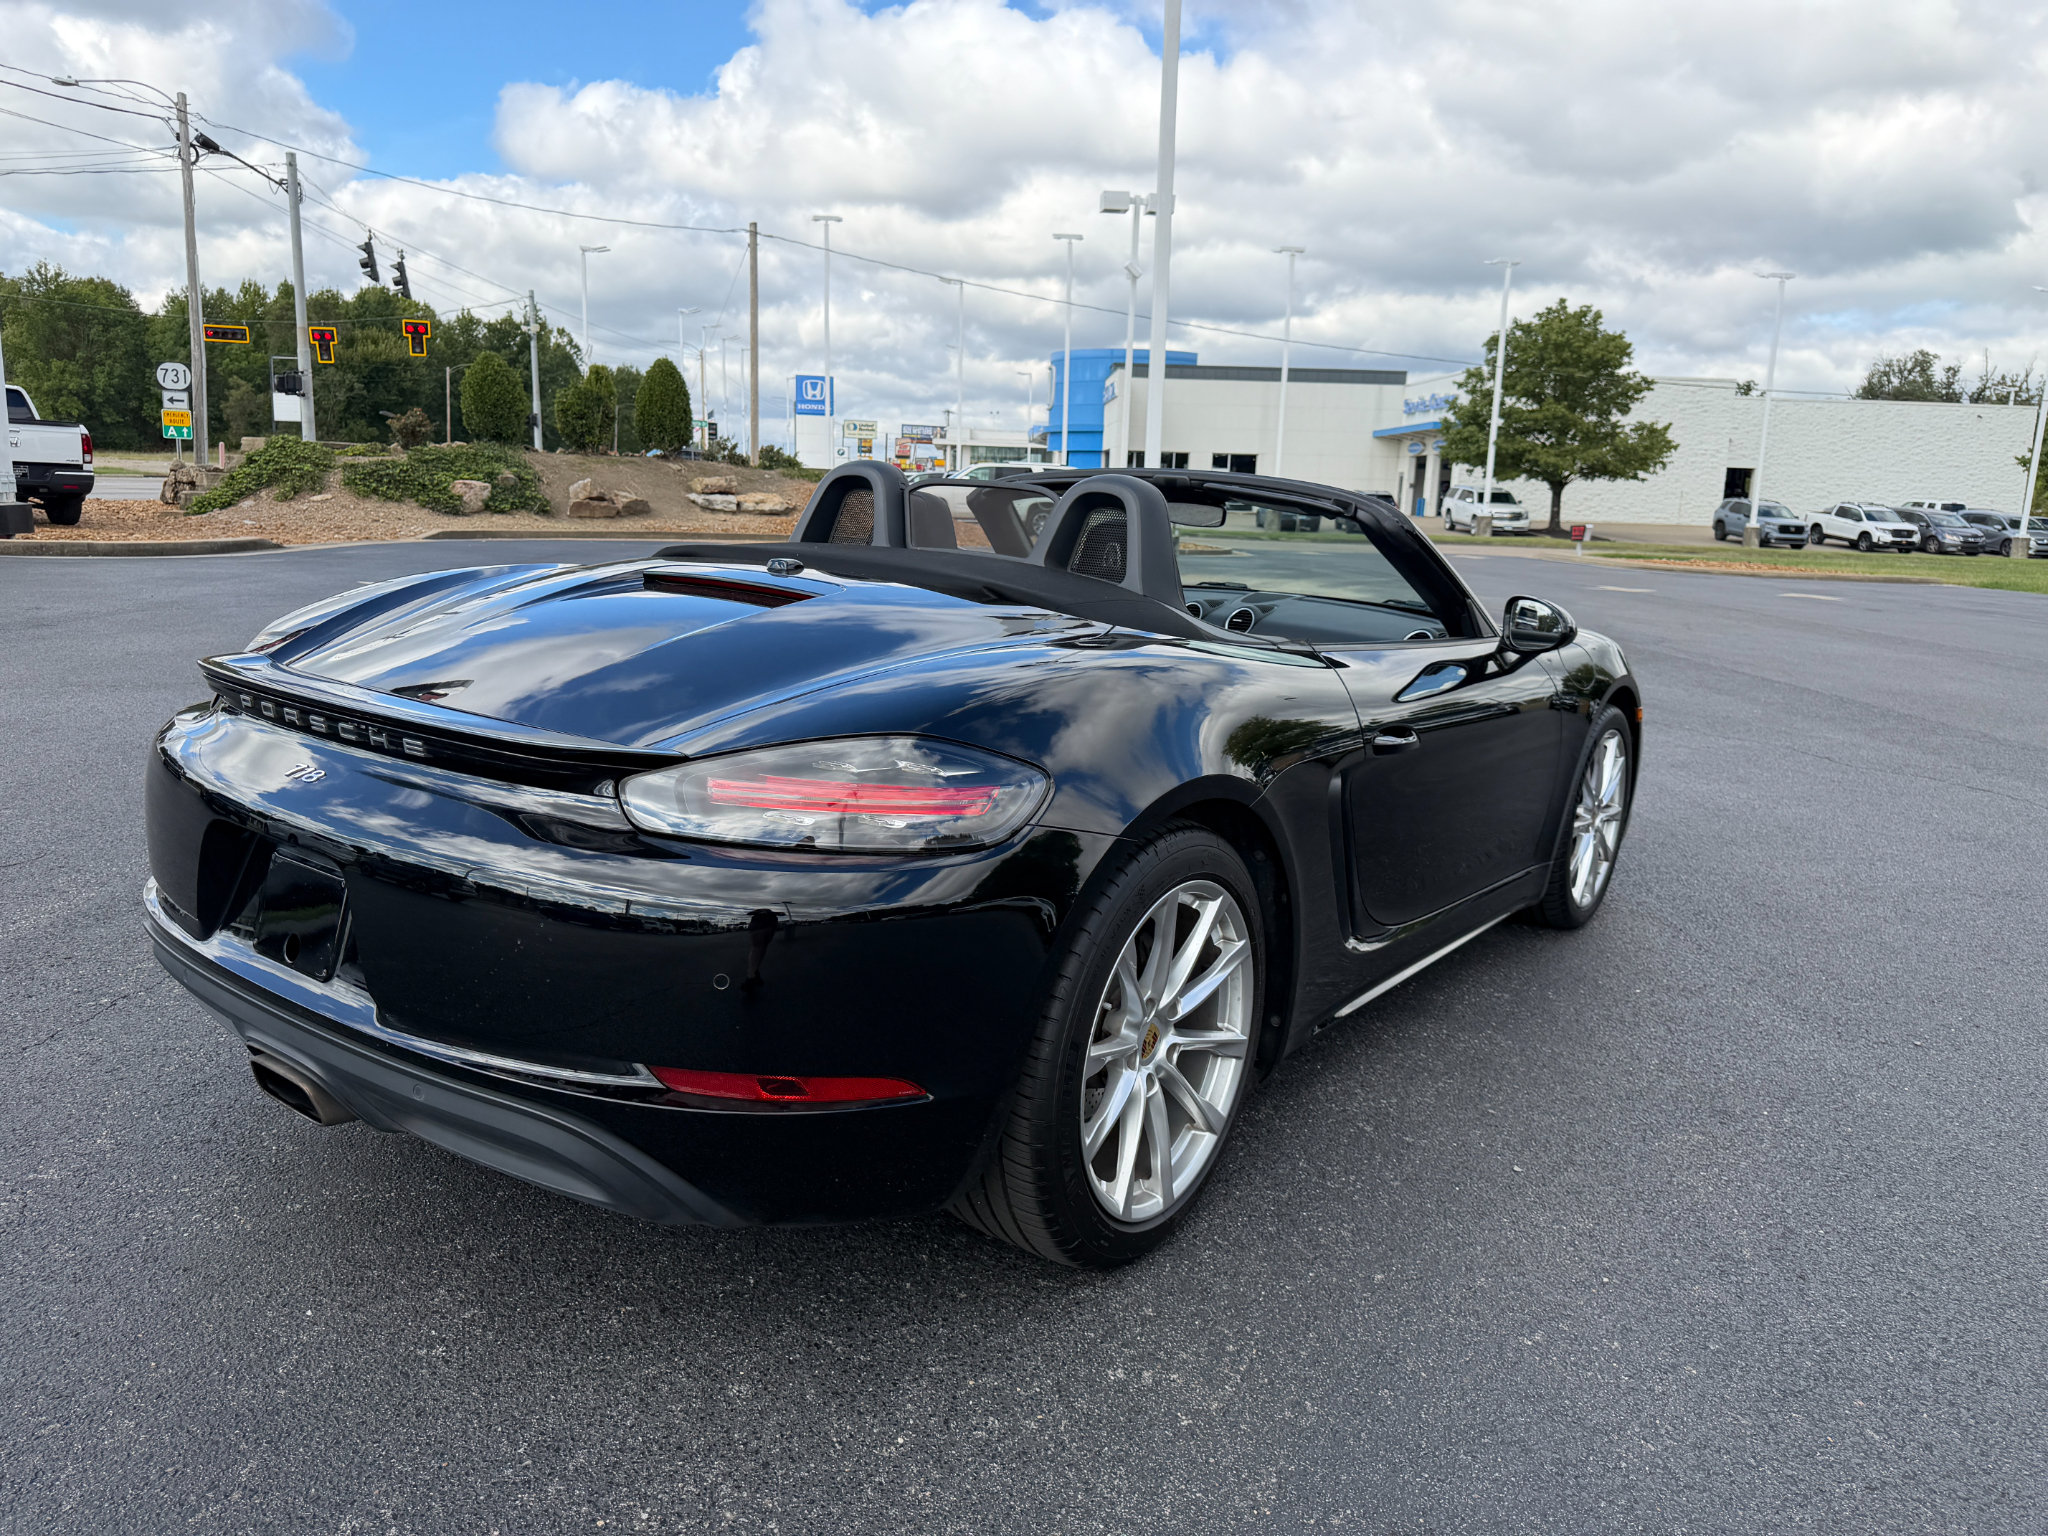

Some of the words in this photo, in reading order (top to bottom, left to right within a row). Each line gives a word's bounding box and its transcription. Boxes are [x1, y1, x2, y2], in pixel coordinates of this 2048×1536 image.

[160, 368, 187, 385] 731
[167, 426, 178, 437] A
[240, 694, 428, 758] PORSCHE
[284, 763, 327, 784] 718
